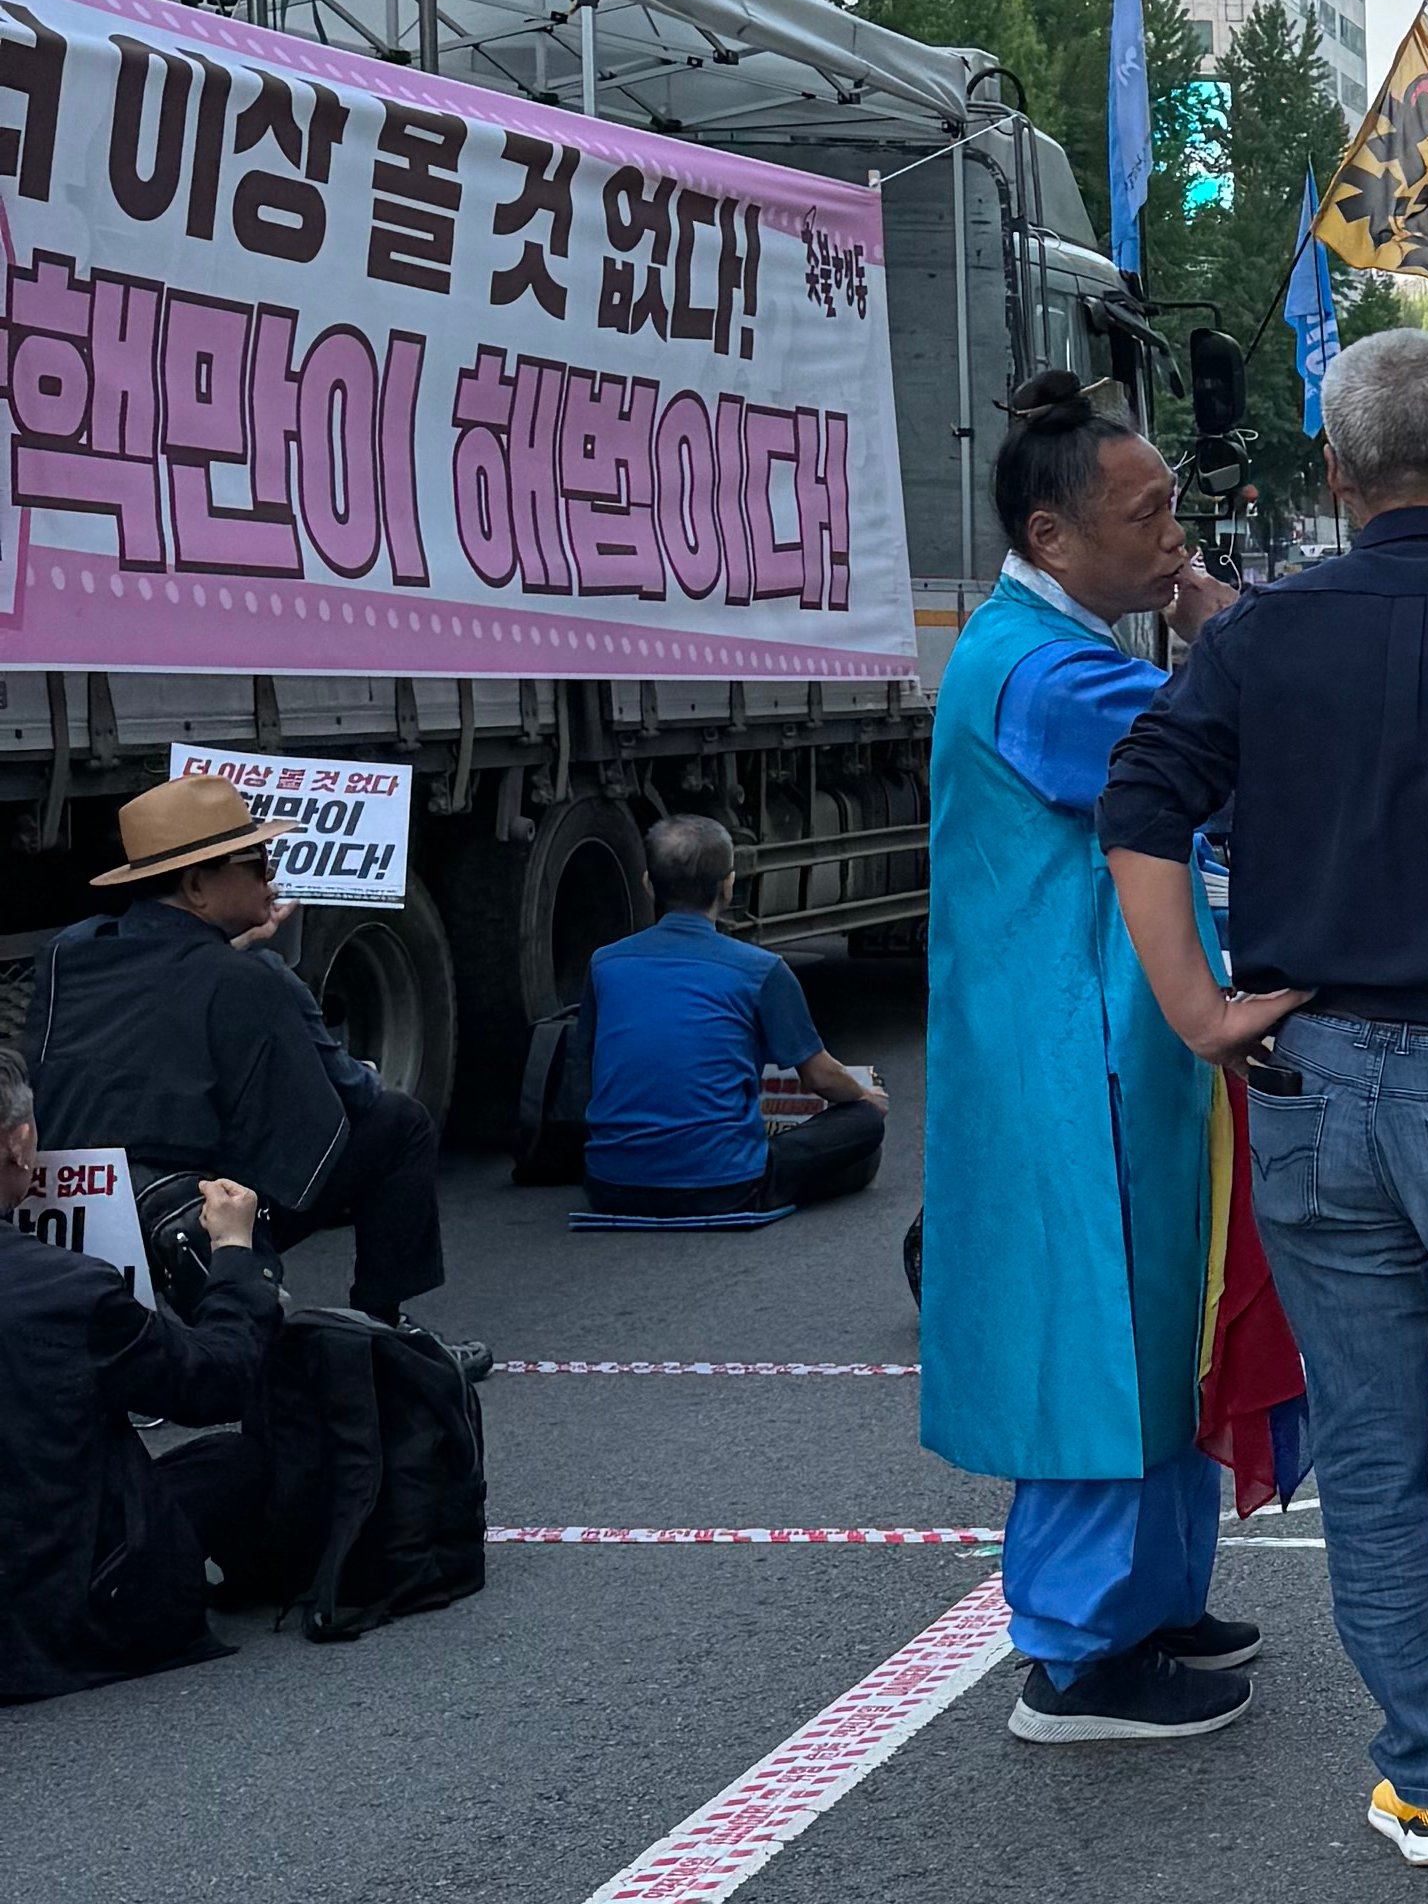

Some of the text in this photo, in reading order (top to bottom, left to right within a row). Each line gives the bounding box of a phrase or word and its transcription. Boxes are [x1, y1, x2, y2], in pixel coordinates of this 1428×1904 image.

[109, 33, 350, 264] 이상
[367, 98, 469, 294] 볼
[490, 131, 580, 320] 것
[597, 163, 764, 360] 없다!
[802, 204, 870, 323] 촛불행동
[6, 246, 850, 611] 핵만이 해법이다!
[218, 760, 273, 789] 이상
[276, 768, 304, 791] 볼
[310, 768, 343, 794] 것
[347, 772, 399, 797] 없다
[57, 1164, 117, 1197] 없다
[705, 1790, 774, 1848] DANGER!
